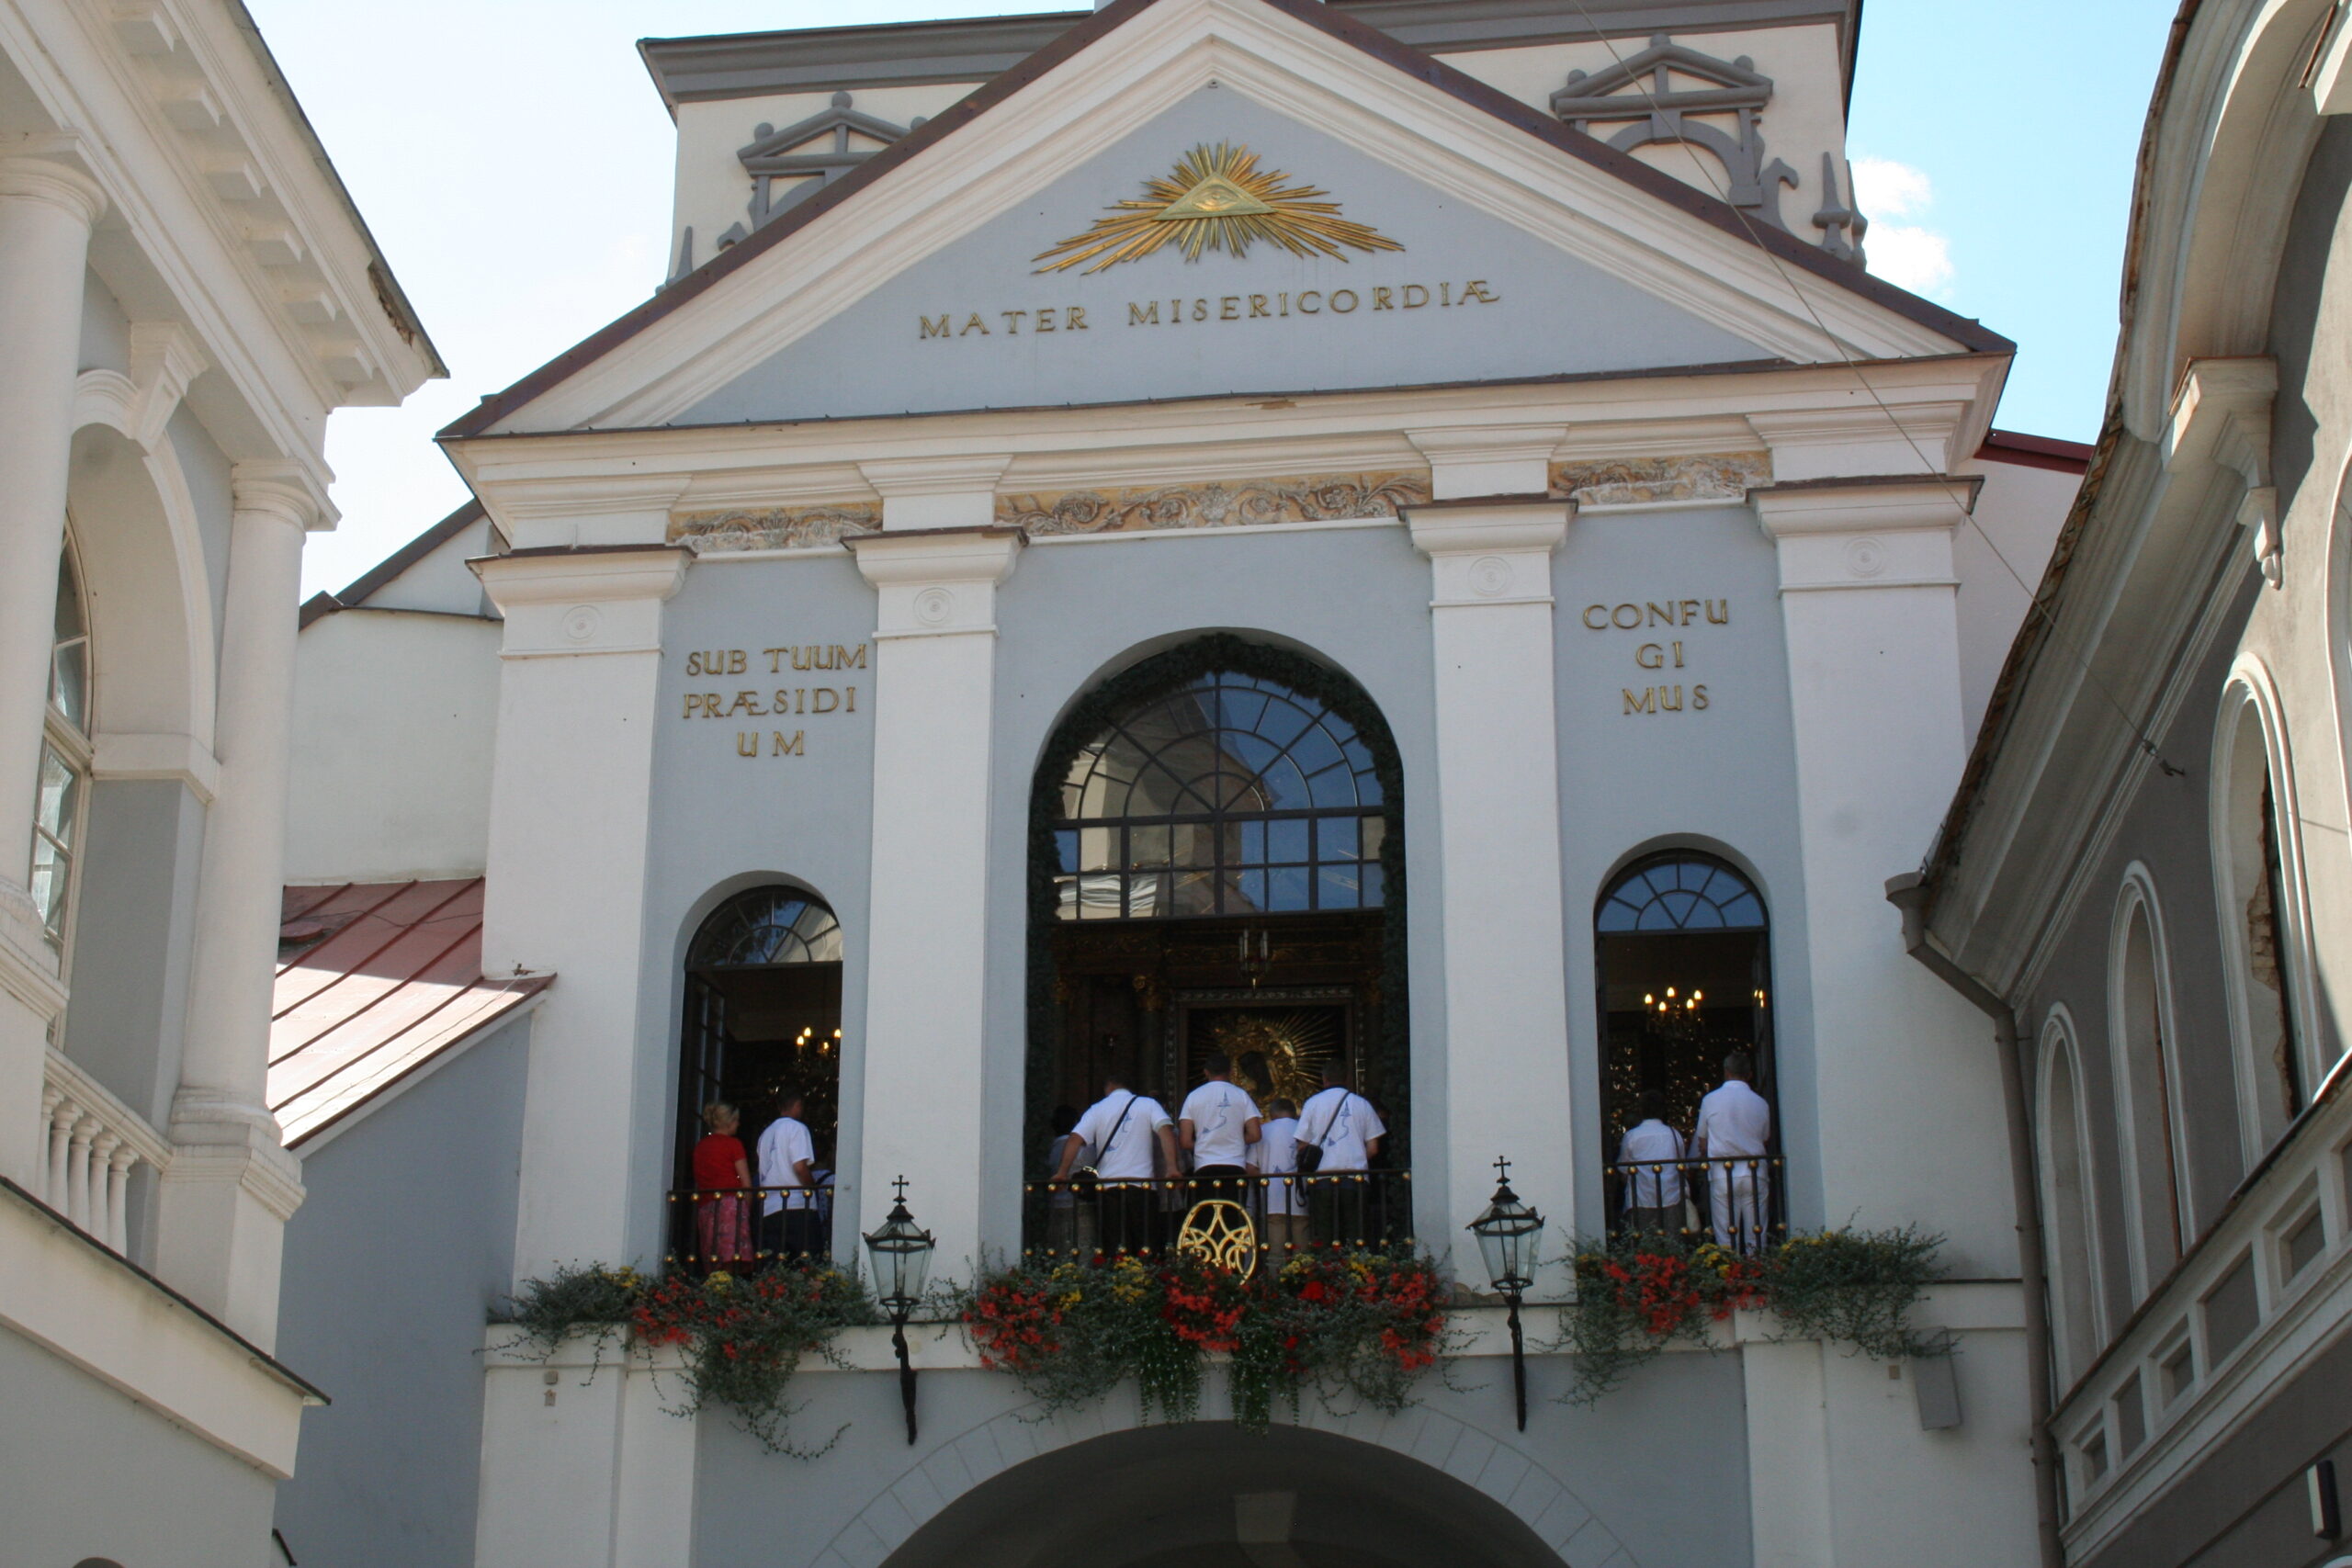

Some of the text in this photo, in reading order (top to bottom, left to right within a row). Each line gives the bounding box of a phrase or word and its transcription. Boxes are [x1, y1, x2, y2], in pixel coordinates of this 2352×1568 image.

[920, 279, 1501, 339] MATER MISERICORDIÆ
[1582, 598, 1729, 630] CONFU
[686, 643, 868, 676] SUB TUUM
[1635, 640, 1685, 670] GI
[683, 686, 856, 719] PRÆSIDI
[1622, 683, 1710, 716] MUS
[736, 729, 805, 758] UM
